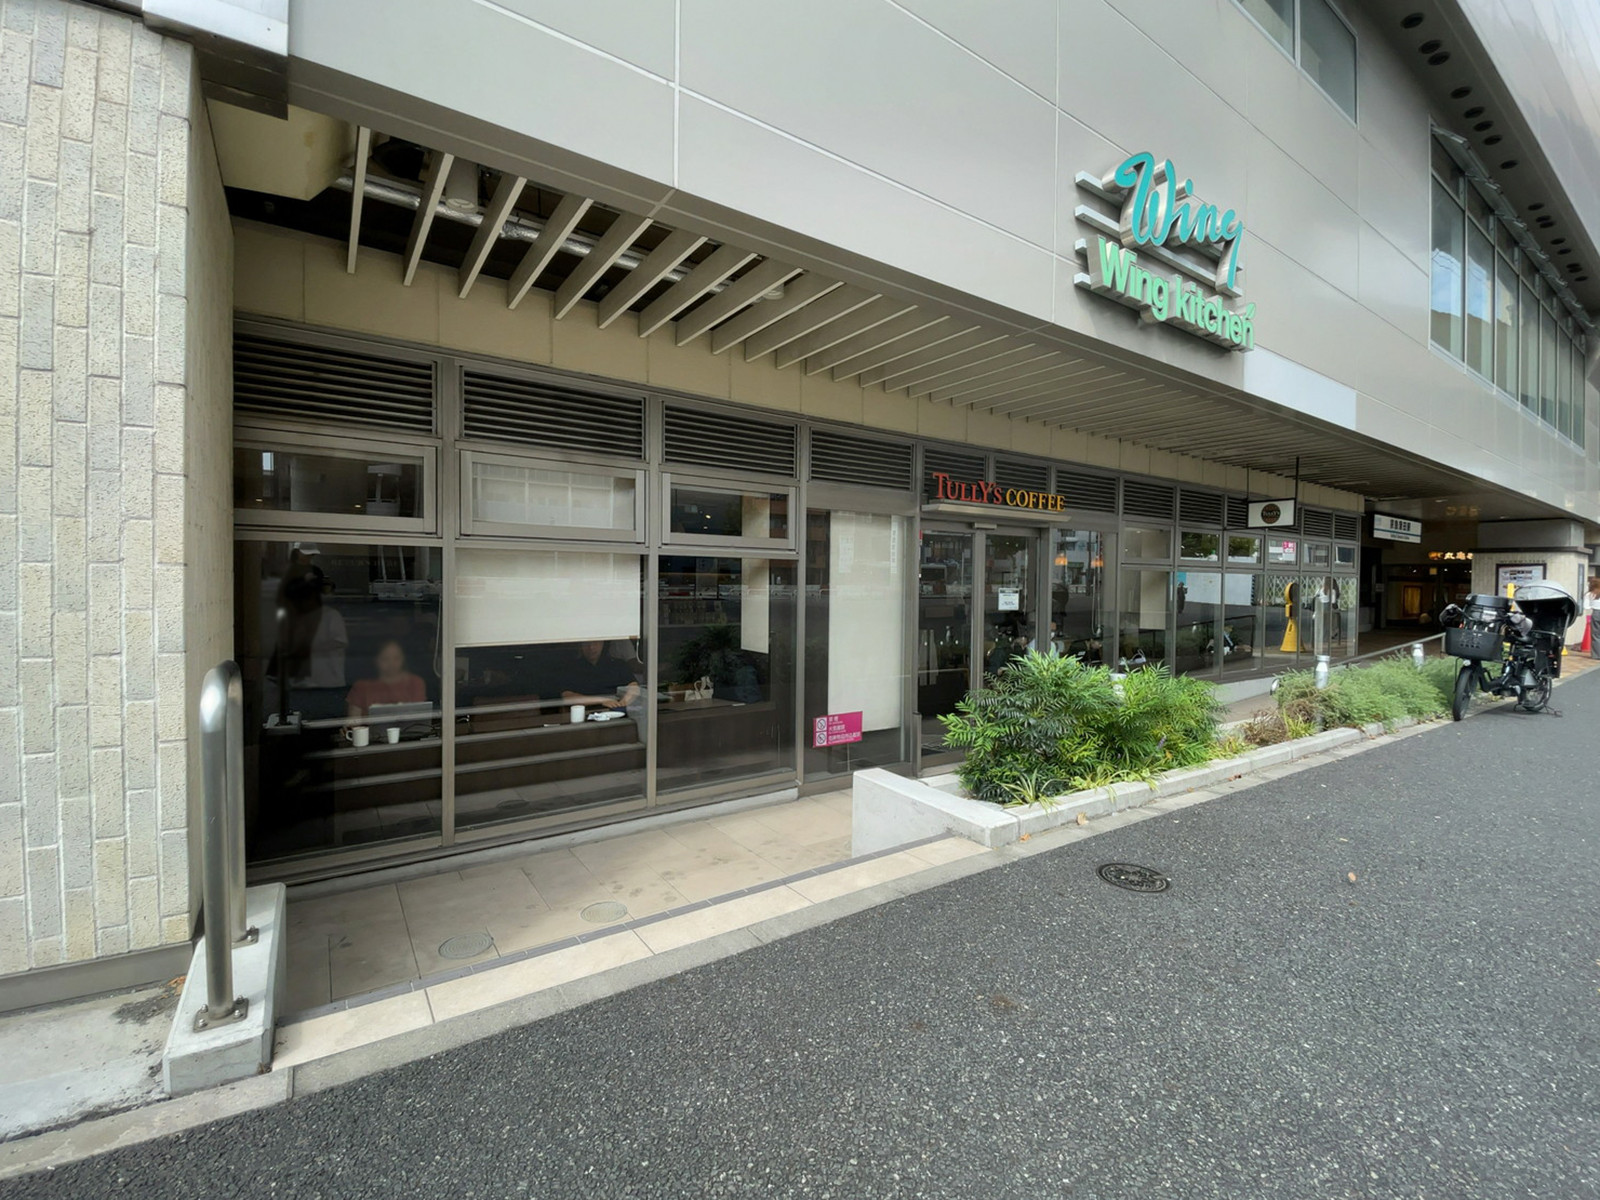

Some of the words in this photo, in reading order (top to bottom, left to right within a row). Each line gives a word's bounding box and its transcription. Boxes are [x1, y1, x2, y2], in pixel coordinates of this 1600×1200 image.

[1114, 152, 1243, 289] Wing
[1098, 234, 1169, 321] Wing
[1175, 273, 1255, 350] kitchen
[932, 471, 1003, 505] TULLY'S
[1006, 488, 1065, 512] COFFEE
